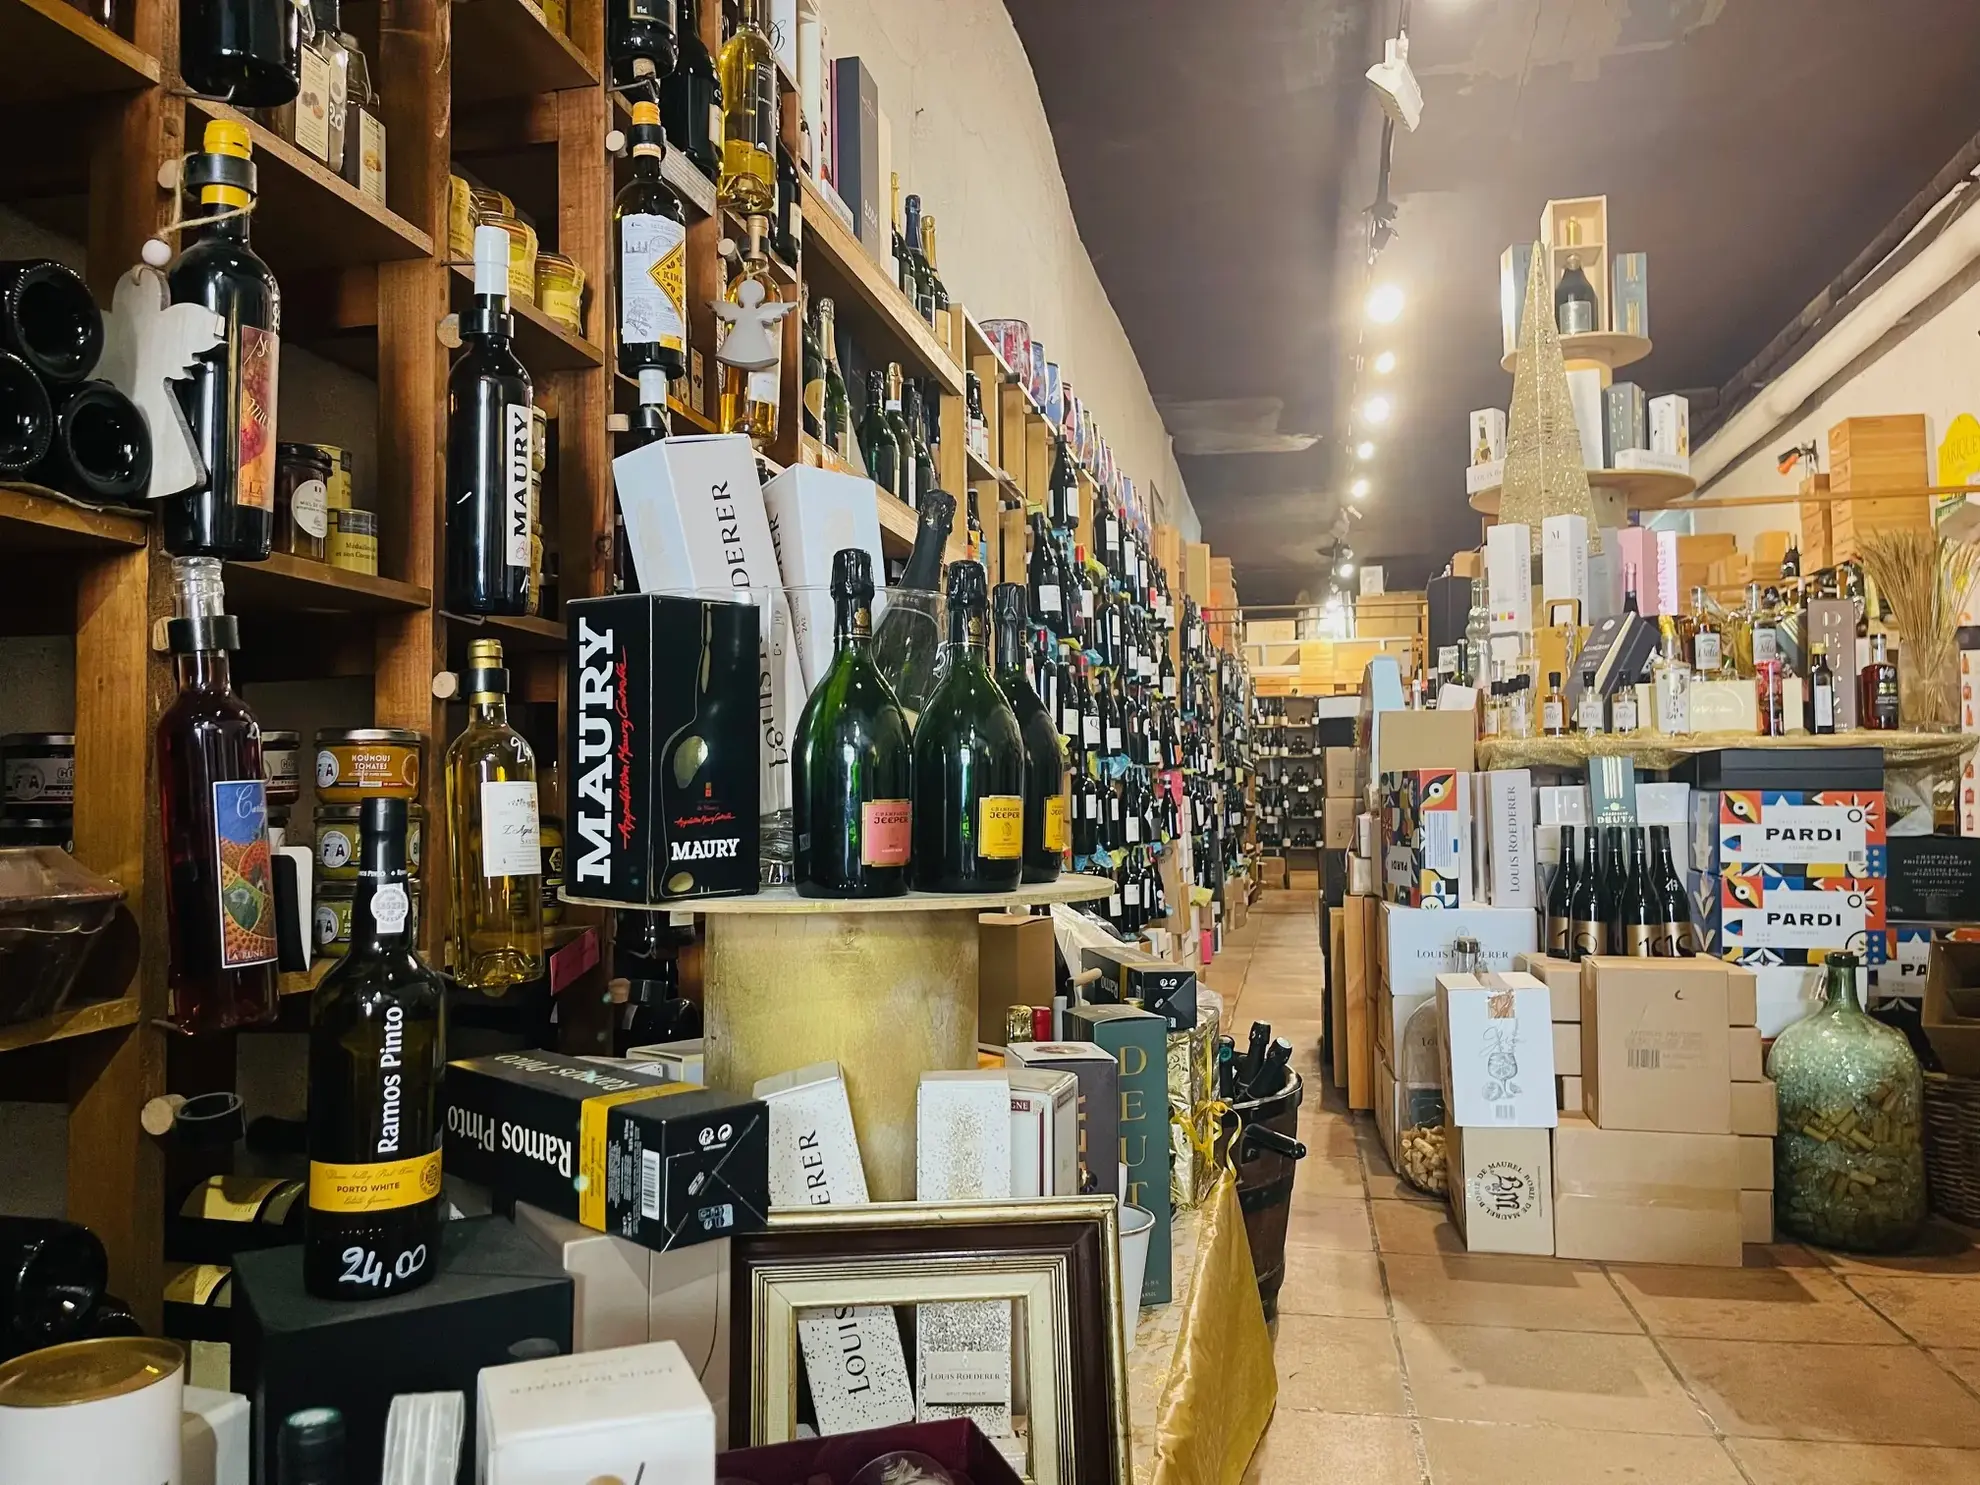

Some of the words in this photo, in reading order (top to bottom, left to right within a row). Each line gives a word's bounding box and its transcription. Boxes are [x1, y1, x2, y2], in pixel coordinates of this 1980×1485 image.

[514, 412, 528, 537] MAURY
[577, 617, 613, 884] MAURY
[874, 816, 908, 824] JEEPER
[990, 811, 1020, 819] JEEPER
[1507, 787, 1517, 852] ROEDERER
[1597, 816, 1635, 824] DEUTZ
[1766, 828, 1841, 841] PARDI
[671, 838, 740, 861] MAURY
[1391, 859, 1408, 871] PARDI
[1511, 855, 1519, 892] LOUIS
[1767, 912, 1841, 926] PARDI
[1417, 949, 1448, 958] LOUIS
[380, 1006, 403, 1068] Pinto
[494, 1054, 559, 1072] Pinto
[550, 1068, 639, 1091] Ramos
[378, 1074, 401, 1153] Ramos
[447, 1105, 495, 1152] Pinto
[501, 1121, 571, 1178] Ramos
[798, 1129, 831, 1206] ERER
[1488, 1161, 1523, 1174] MAUREL
[337, 1185, 367, 1193] PORTO
[371, 1182, 400, 1191] WHITE
[1474, 1181, 1486, 1208] BORIE
[1523, 1174, 1535, 1201] BORIE
[1485, 1206, 1521, 1221] MAUREL
[338, 1244, 426, 1288] 24,00
[834, 1306, 871, 1395] LOUIS
